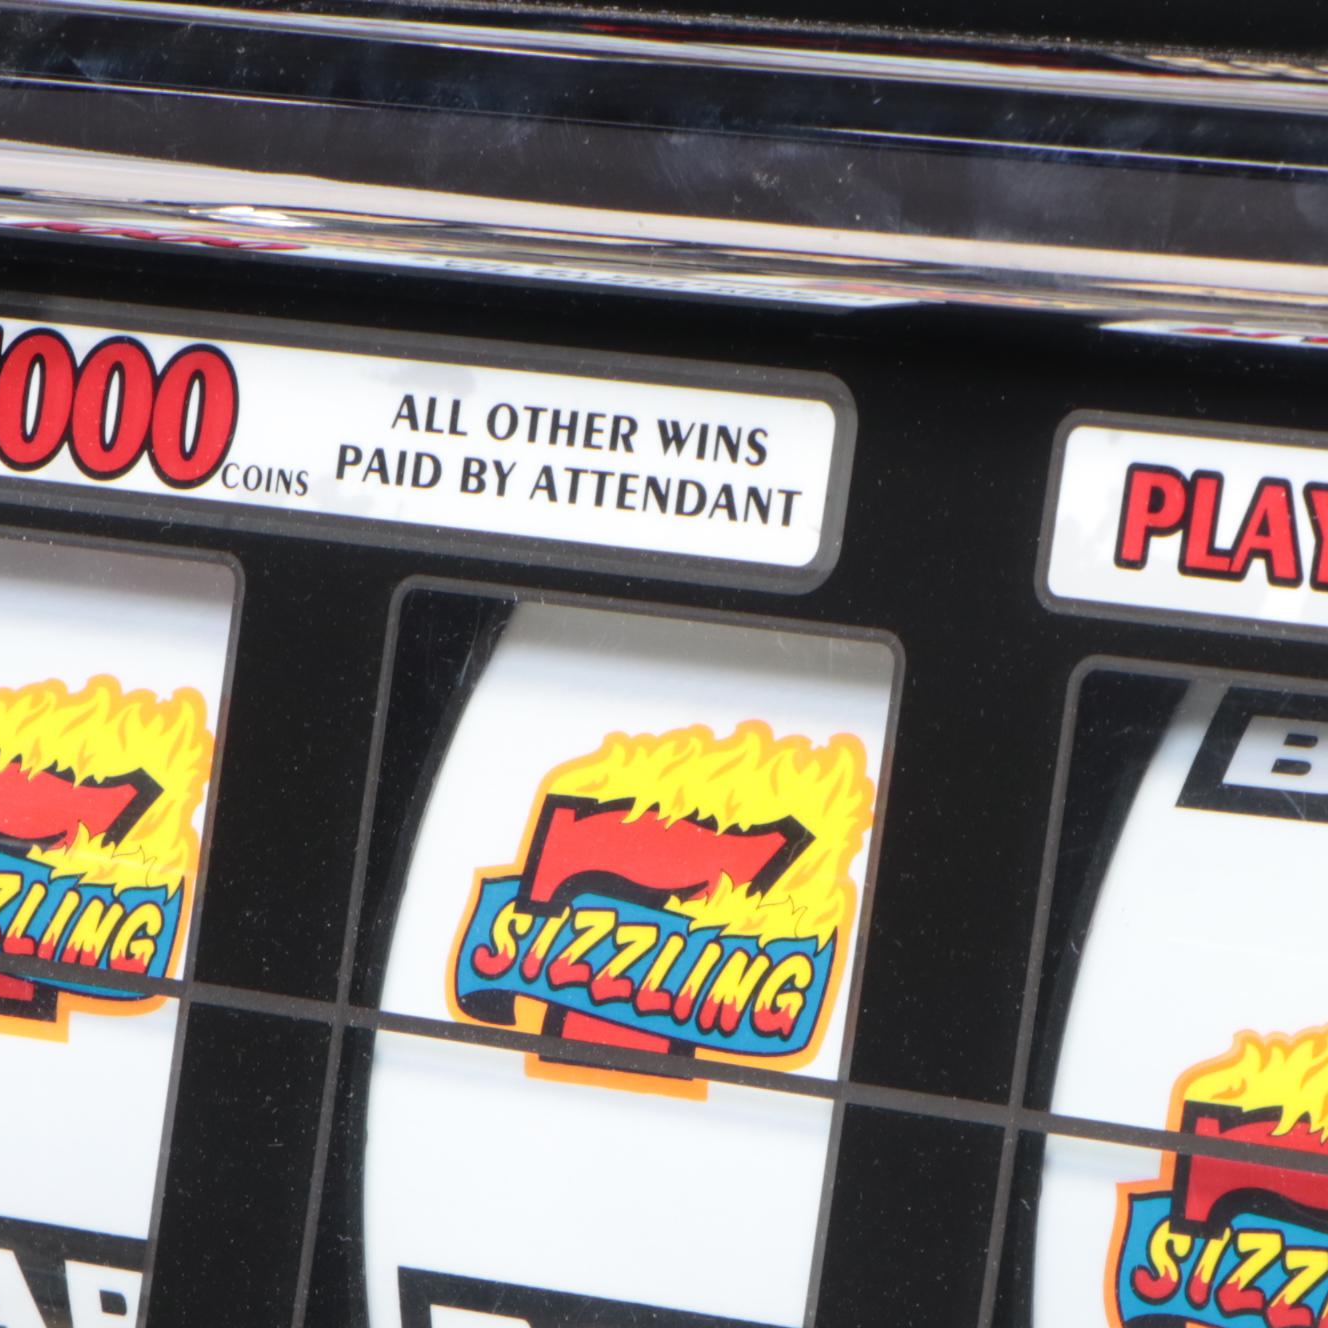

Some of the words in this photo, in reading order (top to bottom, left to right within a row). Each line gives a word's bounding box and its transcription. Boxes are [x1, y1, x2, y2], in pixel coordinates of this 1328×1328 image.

[392, 394, 468, 437] ALL
[486, 403, 638, 452] OTHER
[657, 419, 769, 467] WINS
[221, 462, 309, 496] COINS
[336, 444, 442, 489] PAID
[460, 457, 516, 498] BY
[530, 465, 802, 528] ATTENDANT
[472, 900, 815, 1041] SIZZLING
